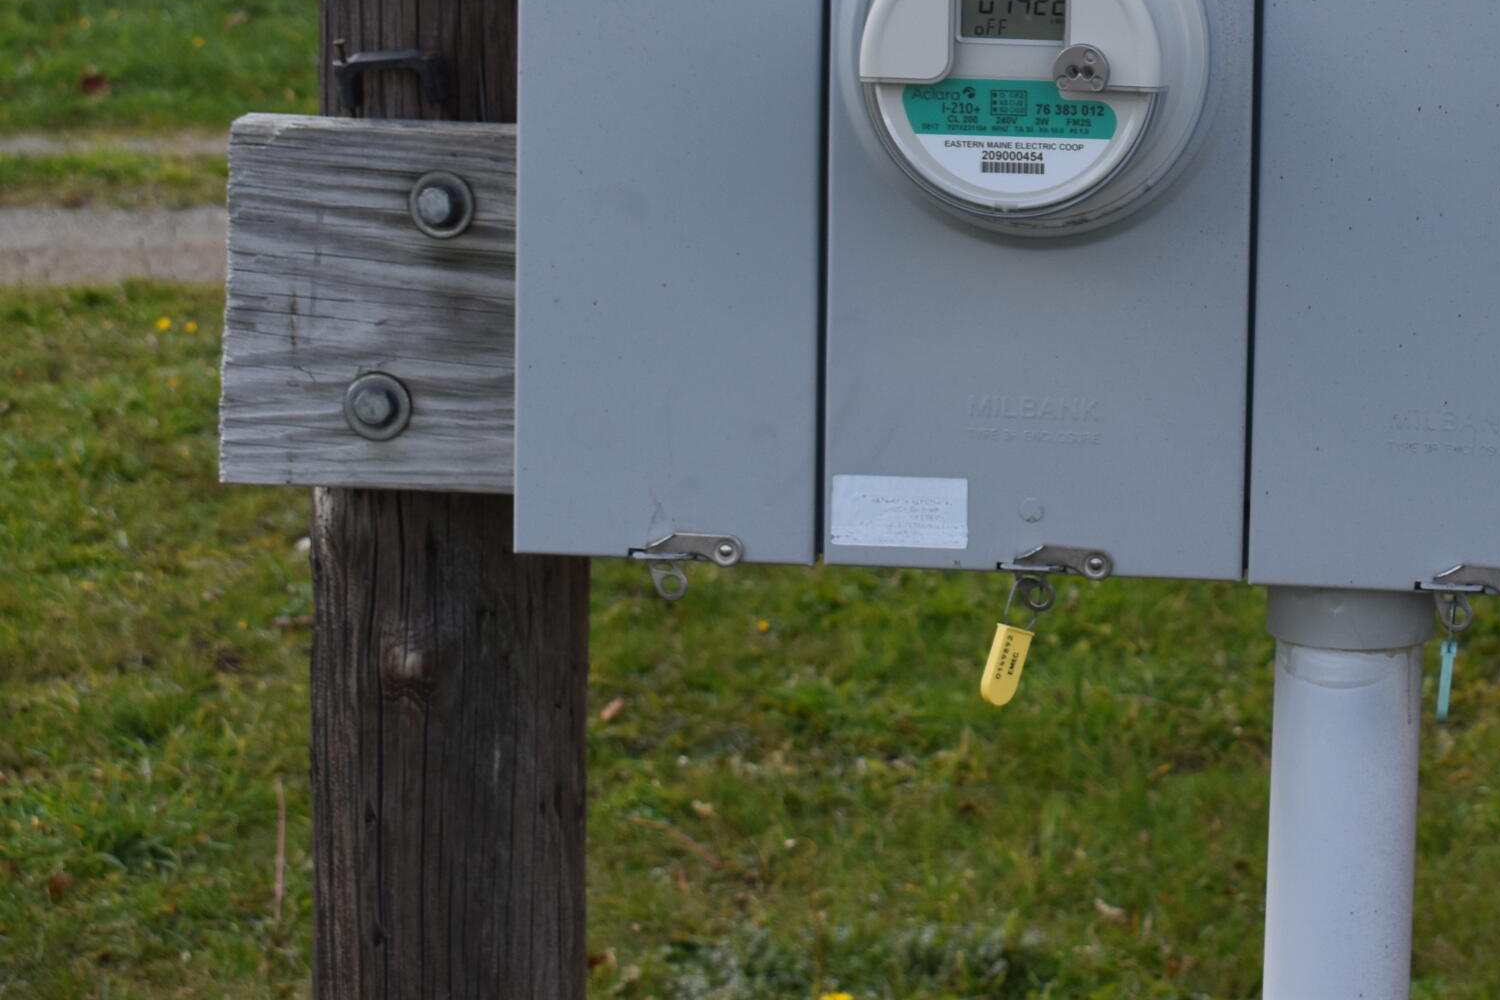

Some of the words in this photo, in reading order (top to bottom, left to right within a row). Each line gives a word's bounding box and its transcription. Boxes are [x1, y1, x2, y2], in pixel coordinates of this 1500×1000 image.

[911, 88, 961, 101] Aclara
[941, 103, 981, 115] I-210+
[1036, 103, 1051, 115] 76
[1055, 104, 1078, 116] 383
[1082, 105, 1105, 117] 012
[947, 115, 960, 123] CL
[1066, 118, 1092, 127] FM2S
[944, 140, 985, 148] EASTERN
[987, 141, 1013, 149] MAINE
[1015, 142, 1057, 151] ELECTRIC
[1058, 143, 1085, 151] COOP
[982, 150, 1044, 161] 209000454
[966, 393, 1100, 422] MILBANK
